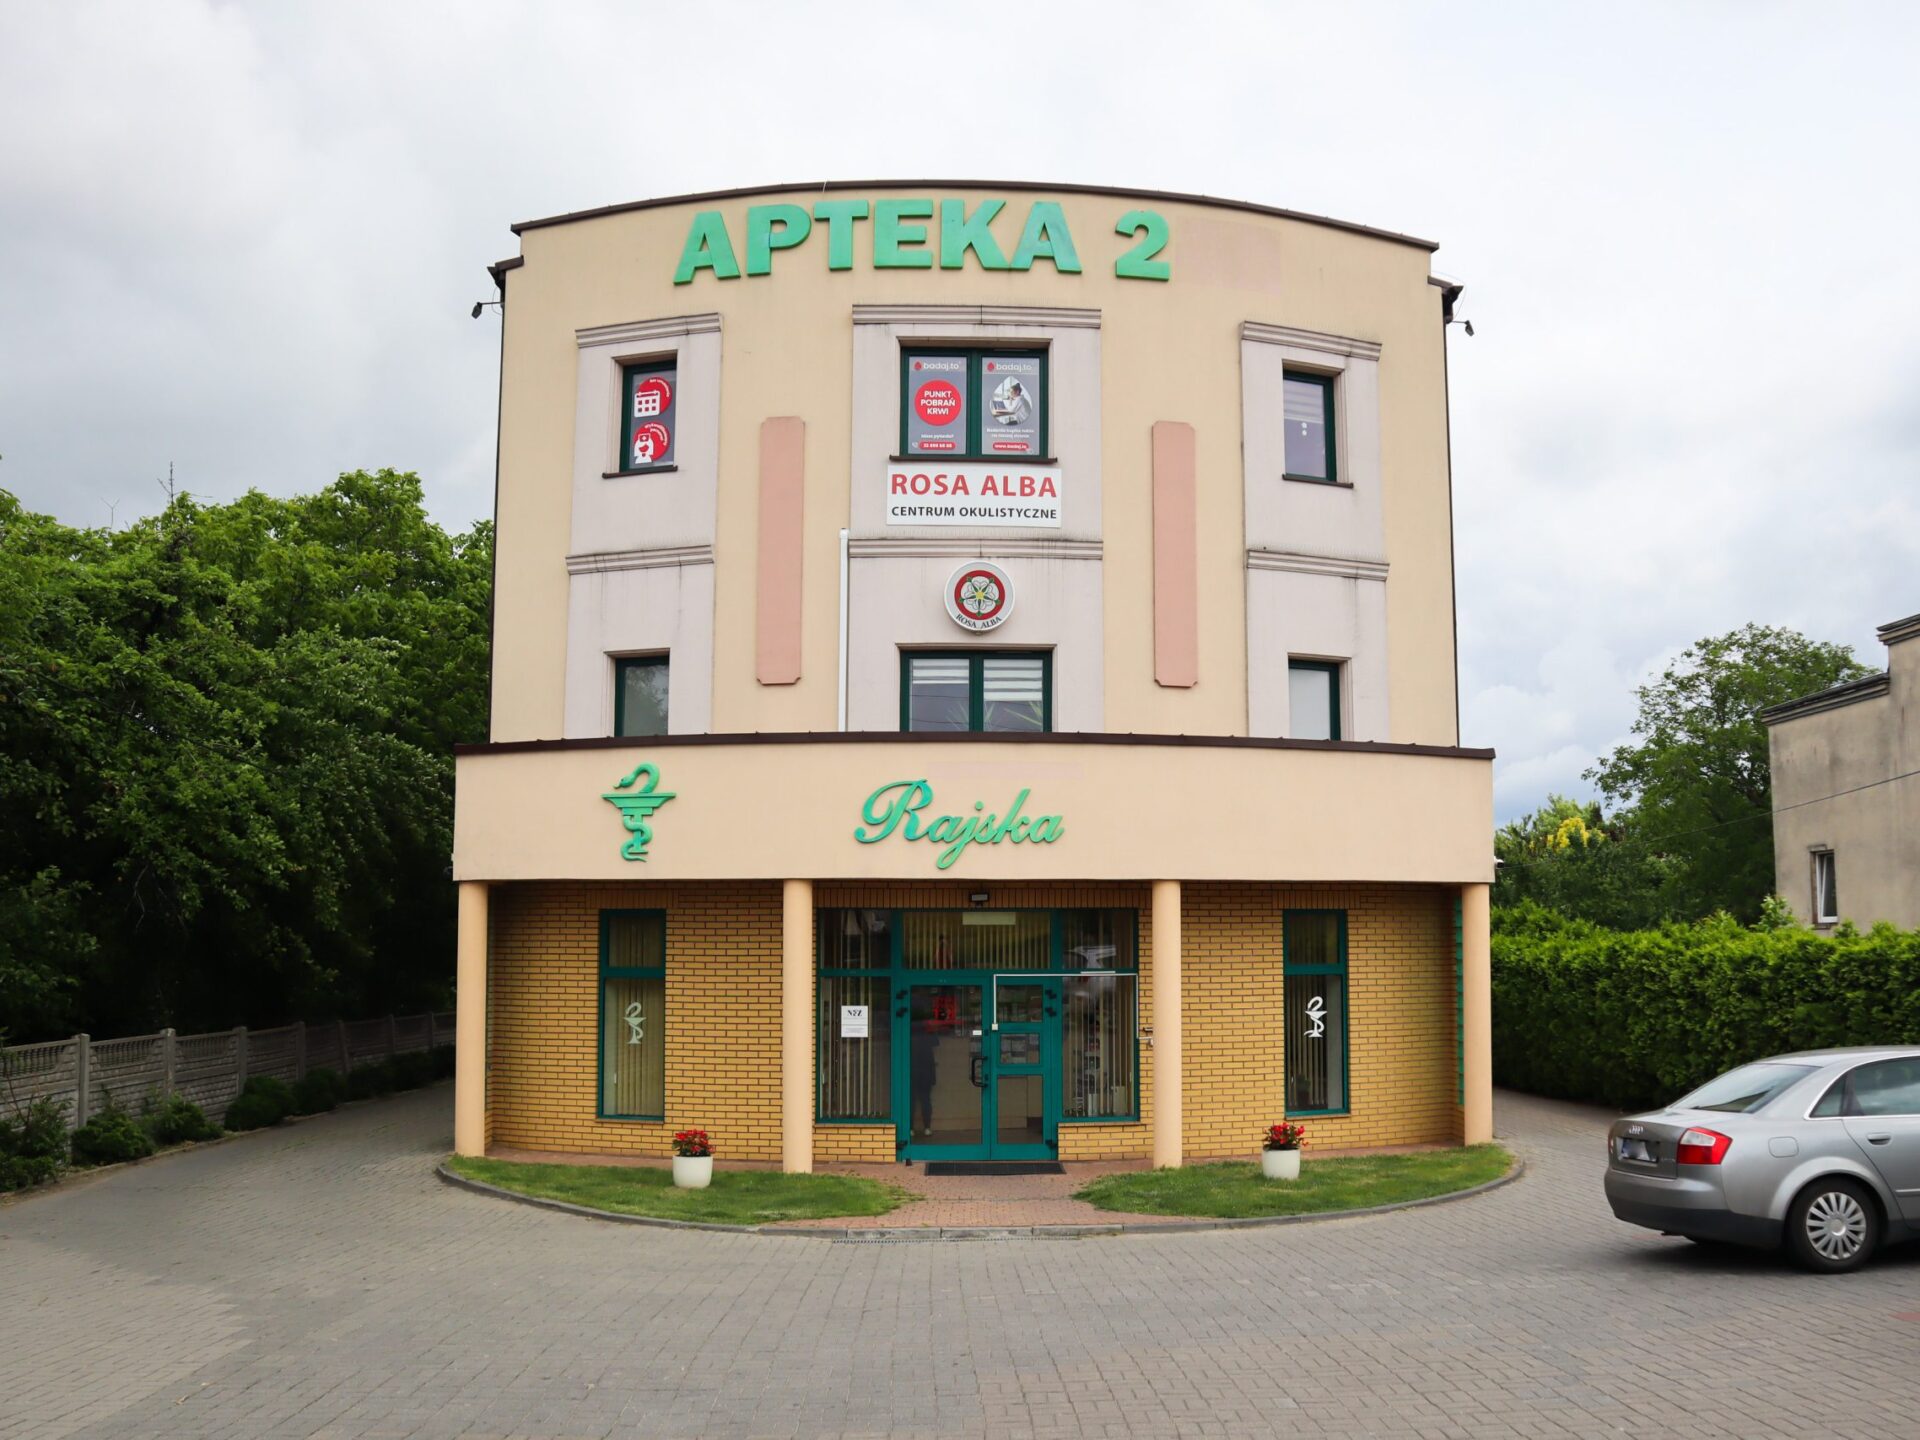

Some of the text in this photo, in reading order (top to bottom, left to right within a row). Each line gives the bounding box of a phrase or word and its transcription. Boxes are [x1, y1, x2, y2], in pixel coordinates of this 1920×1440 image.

[674, 199, 1170, 285] APTEKA 2
[923, 362, 959, 371] badaj.to
[996, 363, 1032, 373] badaj.to
[924, 390, 952, 398] PUNKT
[920, 397, 956, 406] POBRAŃ
[927, 407, 949, 415] KRWI
[891, 473, 1057, 498] ROSA ALBA
[891, 506, 1057, 519] CENTRUM OKULISTYCZNE
[956, 613, 1002, 629] ROSA ALBA
[854, 779, 1065, 870] Rajska
